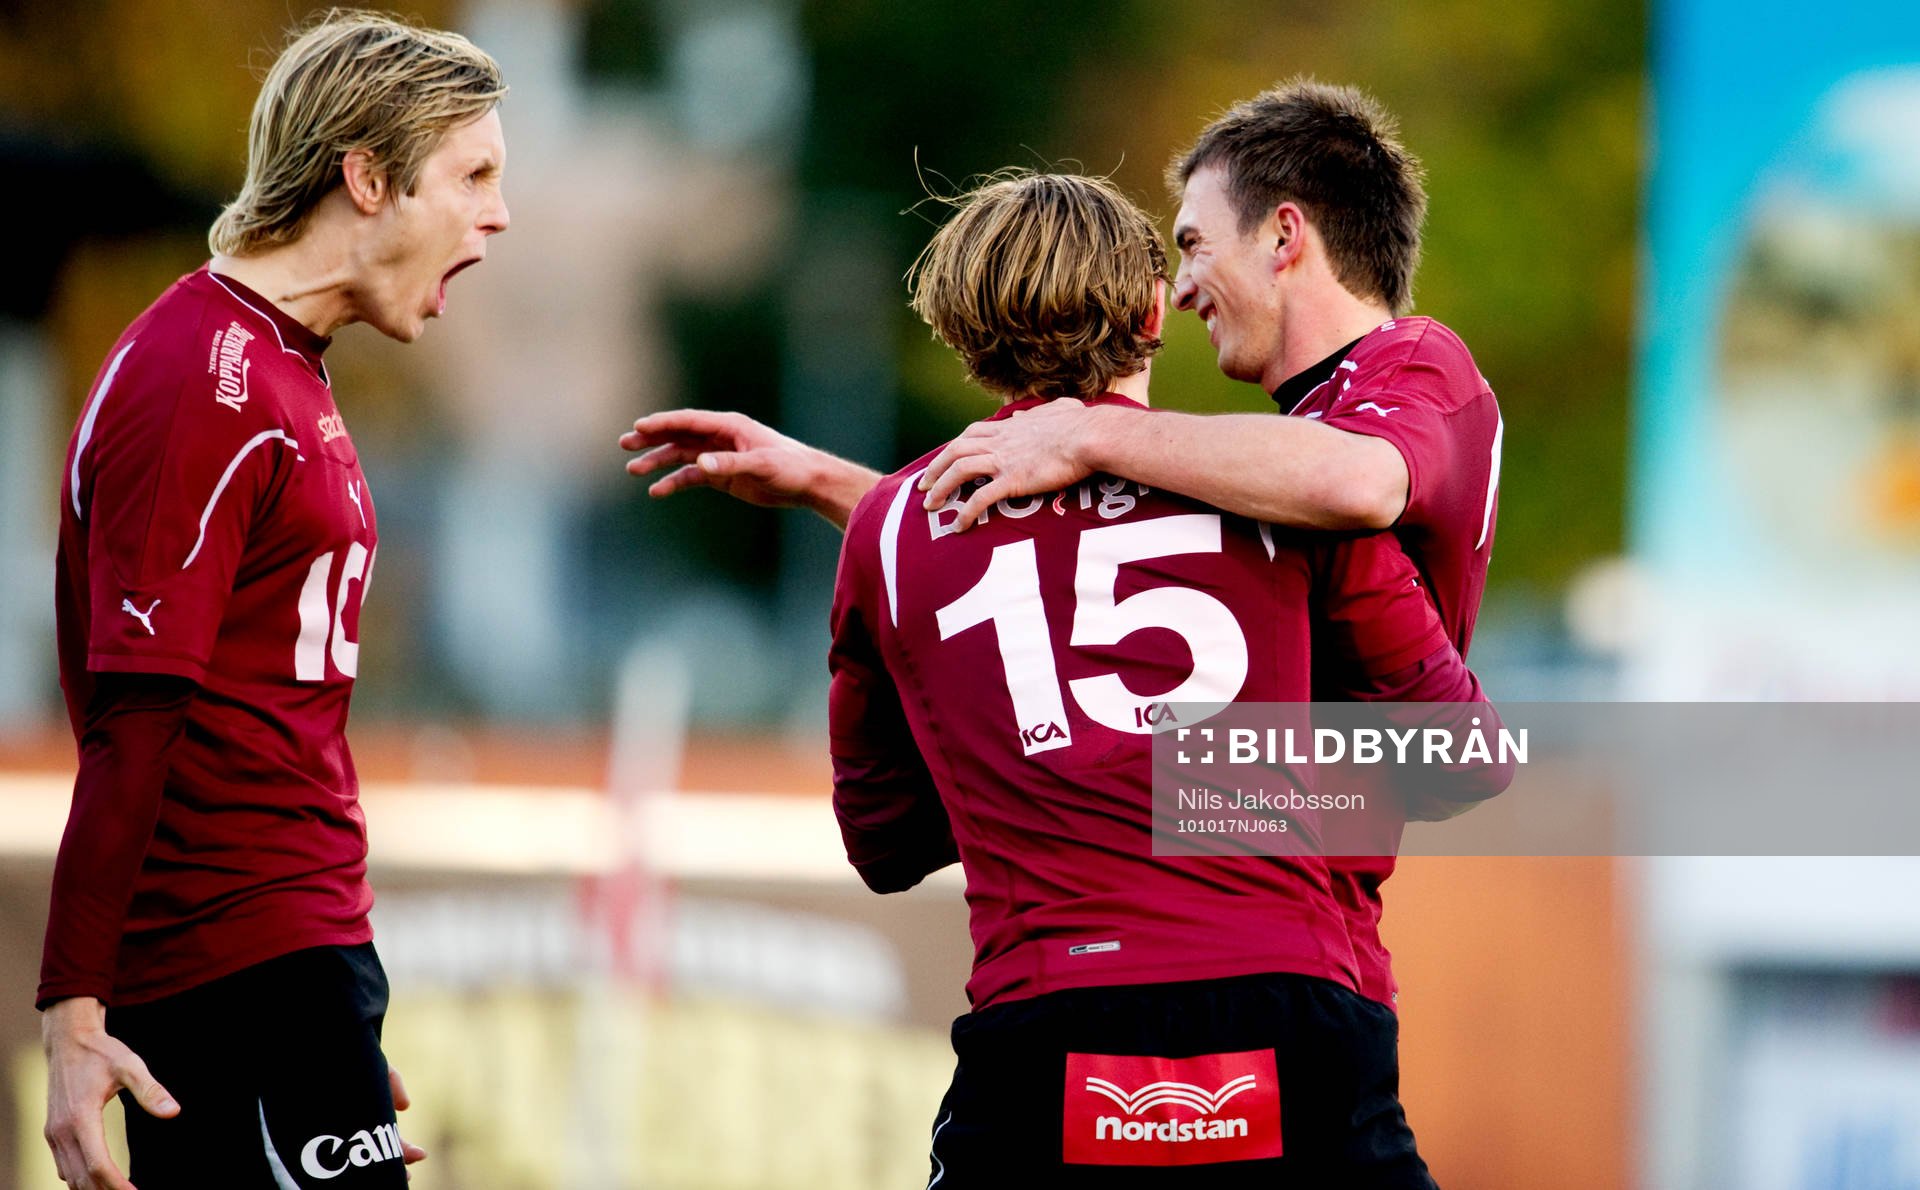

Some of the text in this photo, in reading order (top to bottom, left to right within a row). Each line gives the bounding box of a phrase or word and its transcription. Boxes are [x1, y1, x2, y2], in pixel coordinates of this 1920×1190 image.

[935, 514, 1249, 757] 15
[1022, 722, 1068, 747] ICA
[1134, 703, 1178, 728] ICA
[301, 1122, 404, 1179] Can
